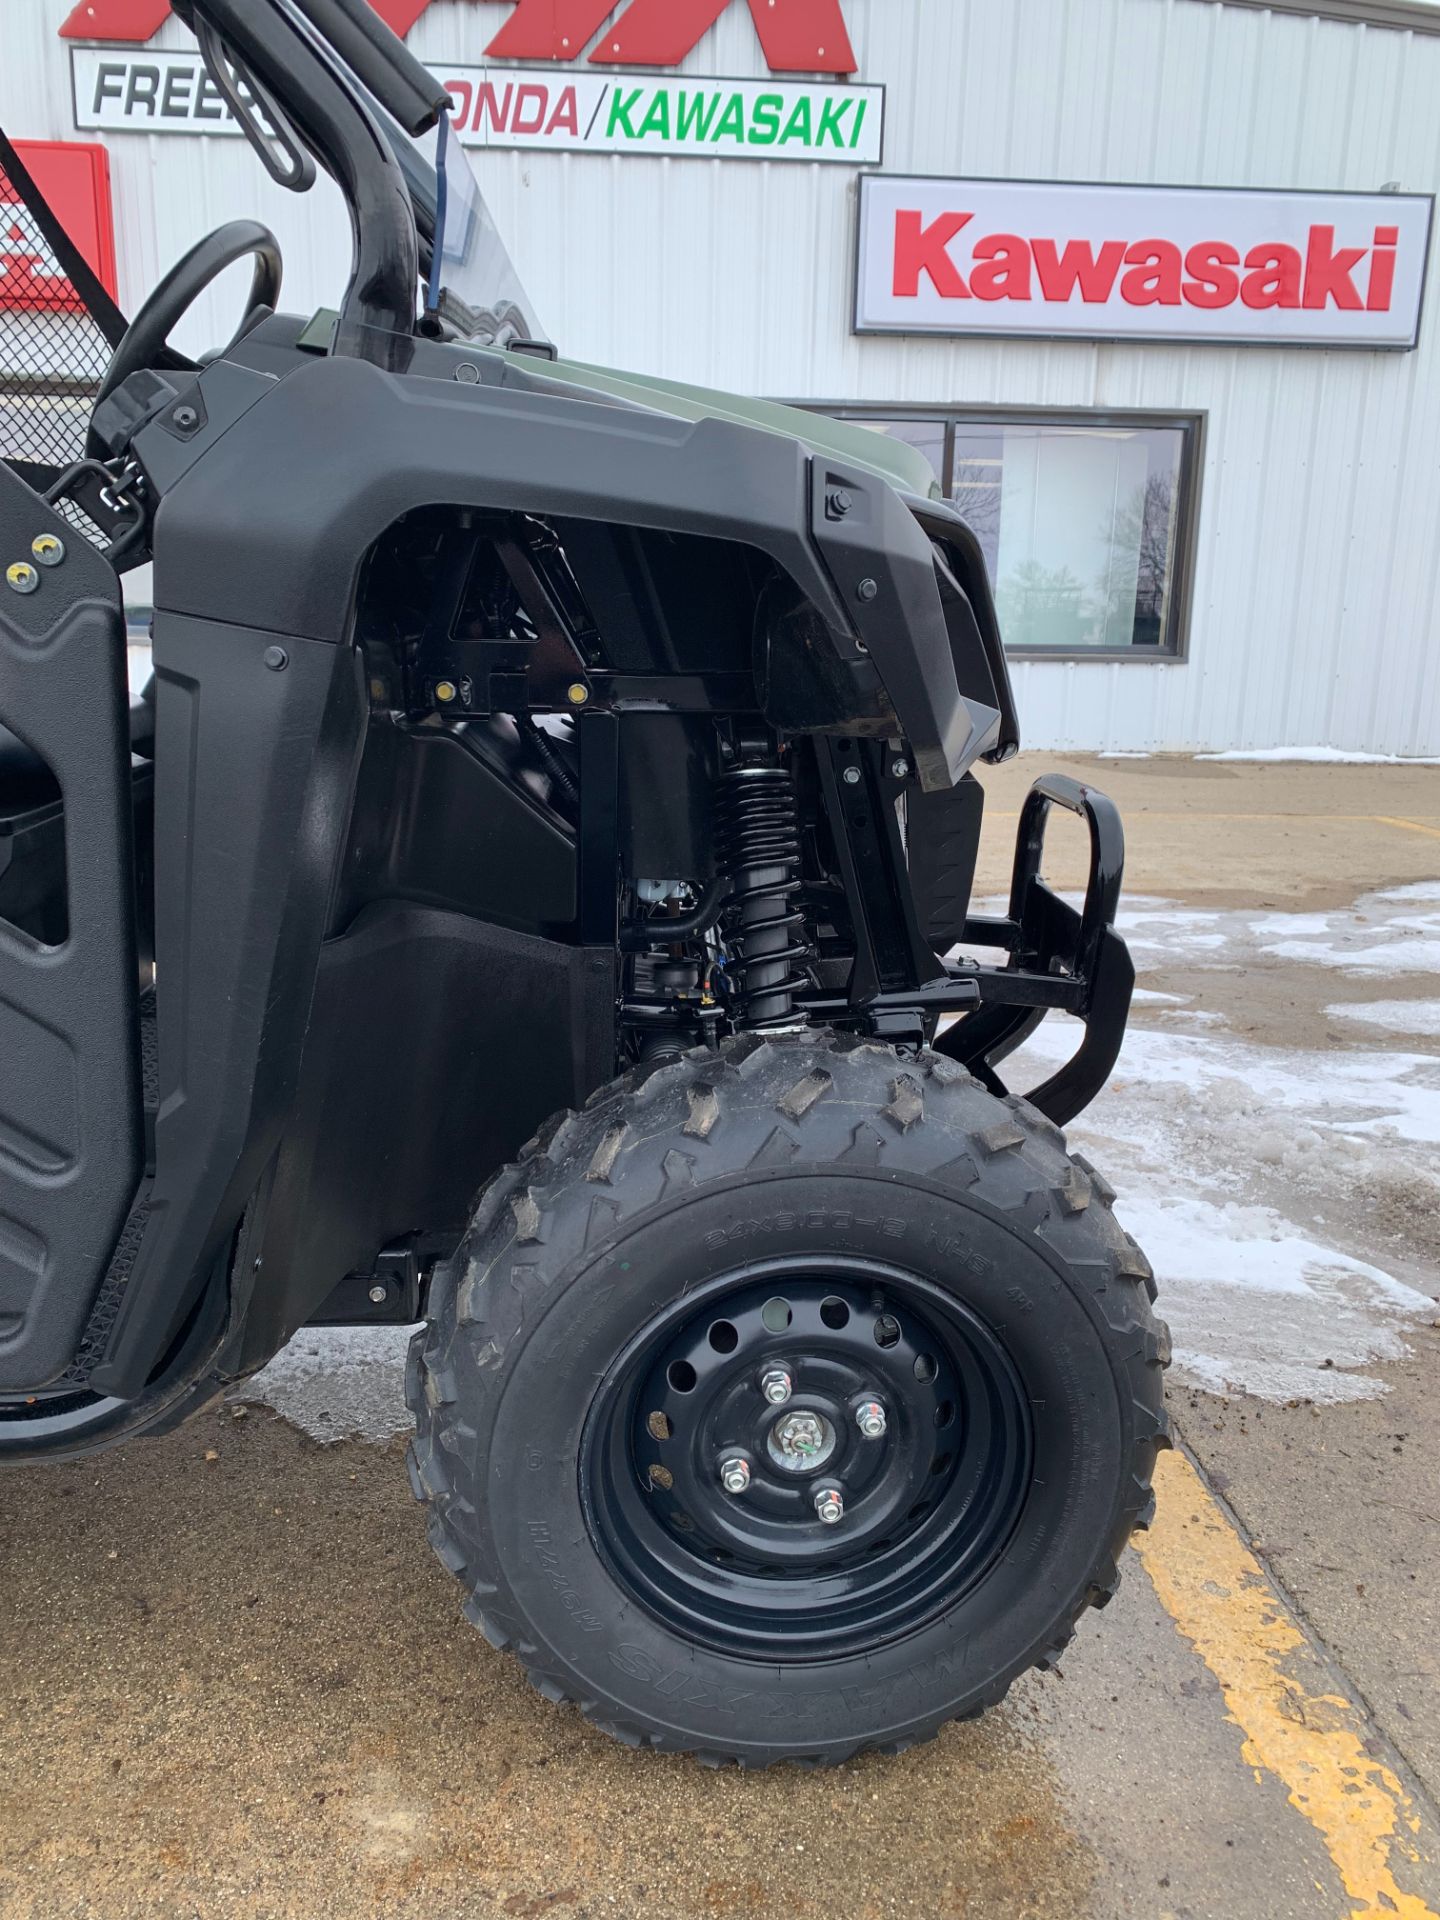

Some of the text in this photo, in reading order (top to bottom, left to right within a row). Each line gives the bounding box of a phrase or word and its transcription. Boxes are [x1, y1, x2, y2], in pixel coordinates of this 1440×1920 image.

[442, 79, 868, 149] ONDA/KAWASAKI
[892, 208, 1400, 313] Kawasaki
[704, 1211, 907, 1251] 24X8.00-12
[923, 1229, 991, 1276] NHS
[607, 1633, 969, 1718] MAXXIS
